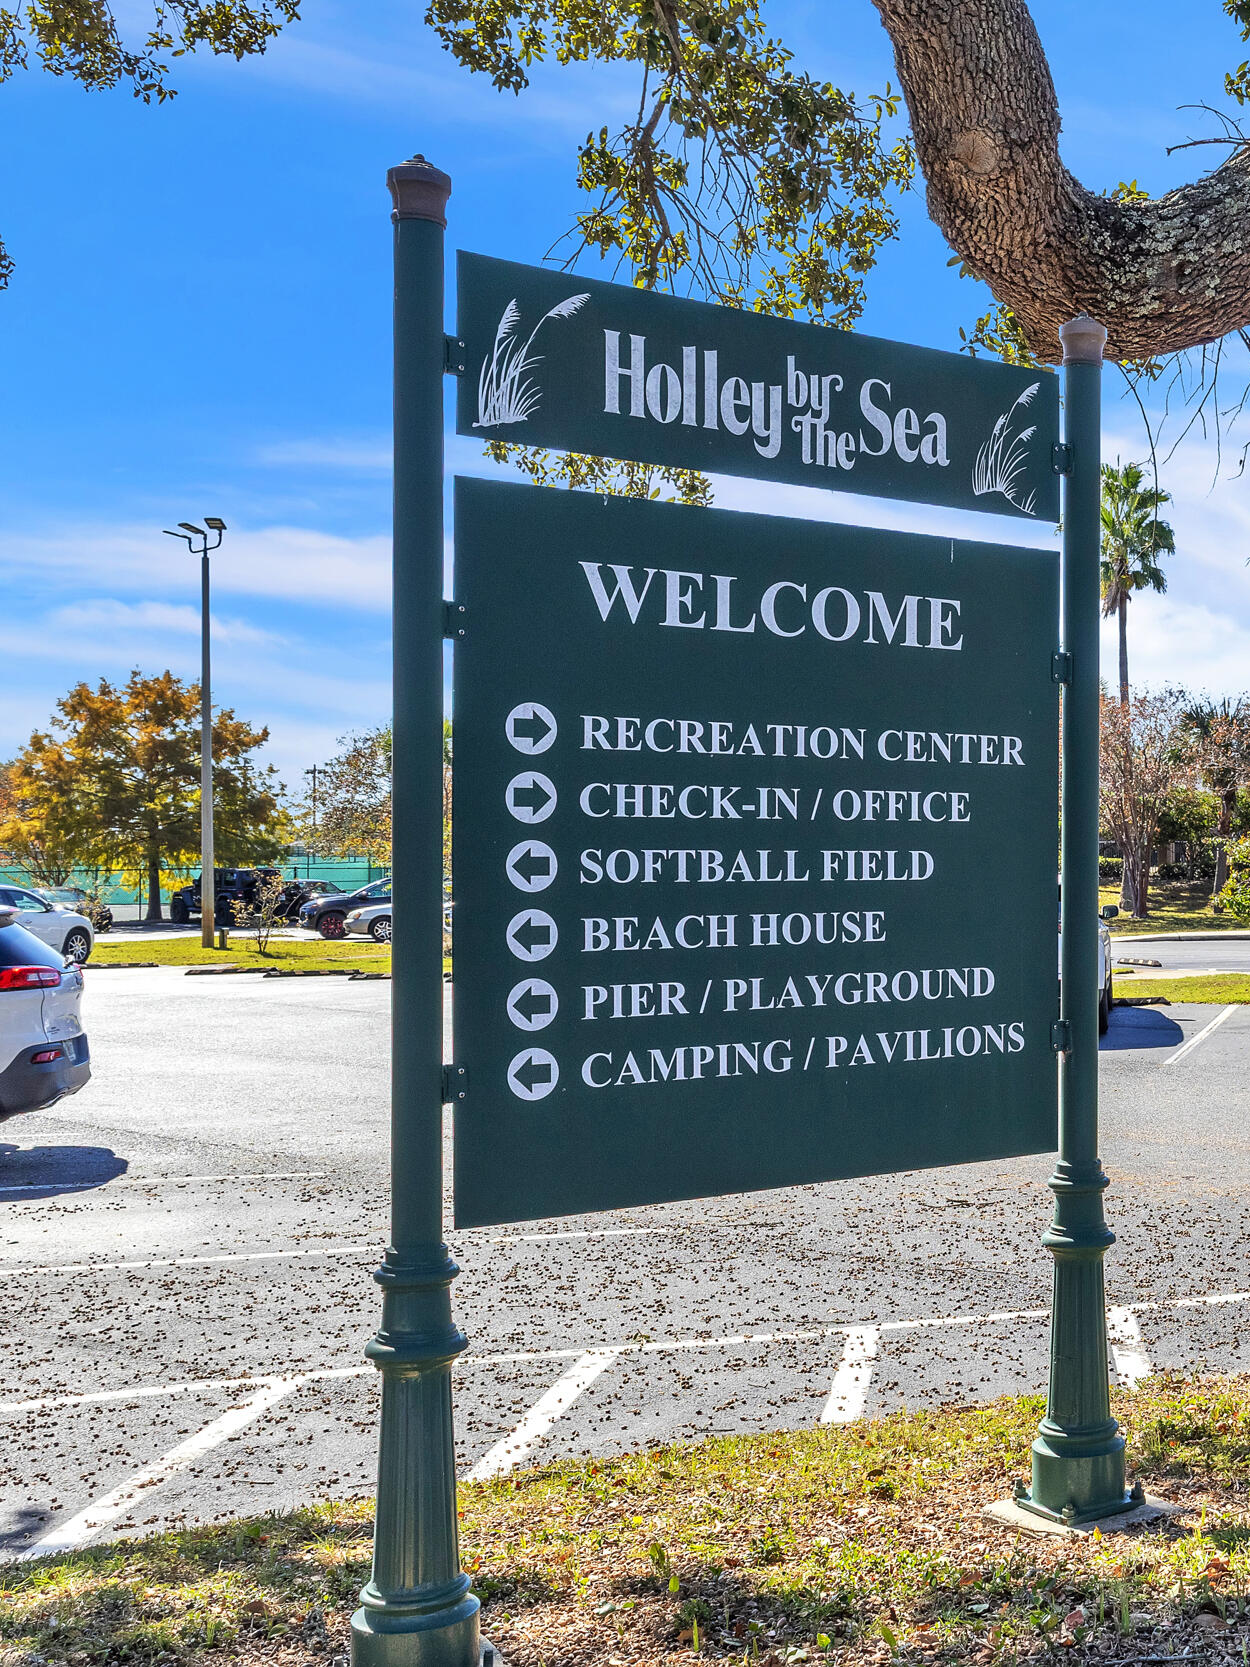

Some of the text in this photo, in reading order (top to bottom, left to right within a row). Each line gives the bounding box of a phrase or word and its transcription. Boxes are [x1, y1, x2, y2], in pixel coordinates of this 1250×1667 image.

[604, 329, 783, 459] Holley
[787, 355, 843, 424] by
[859, 378, 951, 467] Sea
[578, 561, 964, 652] WELCOME
[580, 715, 1026, 767] RECREATION CENTER
[579, 782, 801, 821] CHECK-IN
[833, 789, 971, 823] OFFICE
[580, 848, 935, 885] SOFTBALL FIELD
[581, 911, 887, 953] BEACH HOUSE
[581, 979, 690, 1022] PIER
[723, 966, 996, 1013] PLAYGROUND
[581, 1040, 792, 1089] CAMPING
[826, 1021, 1026, 1070] PAVILIONS
